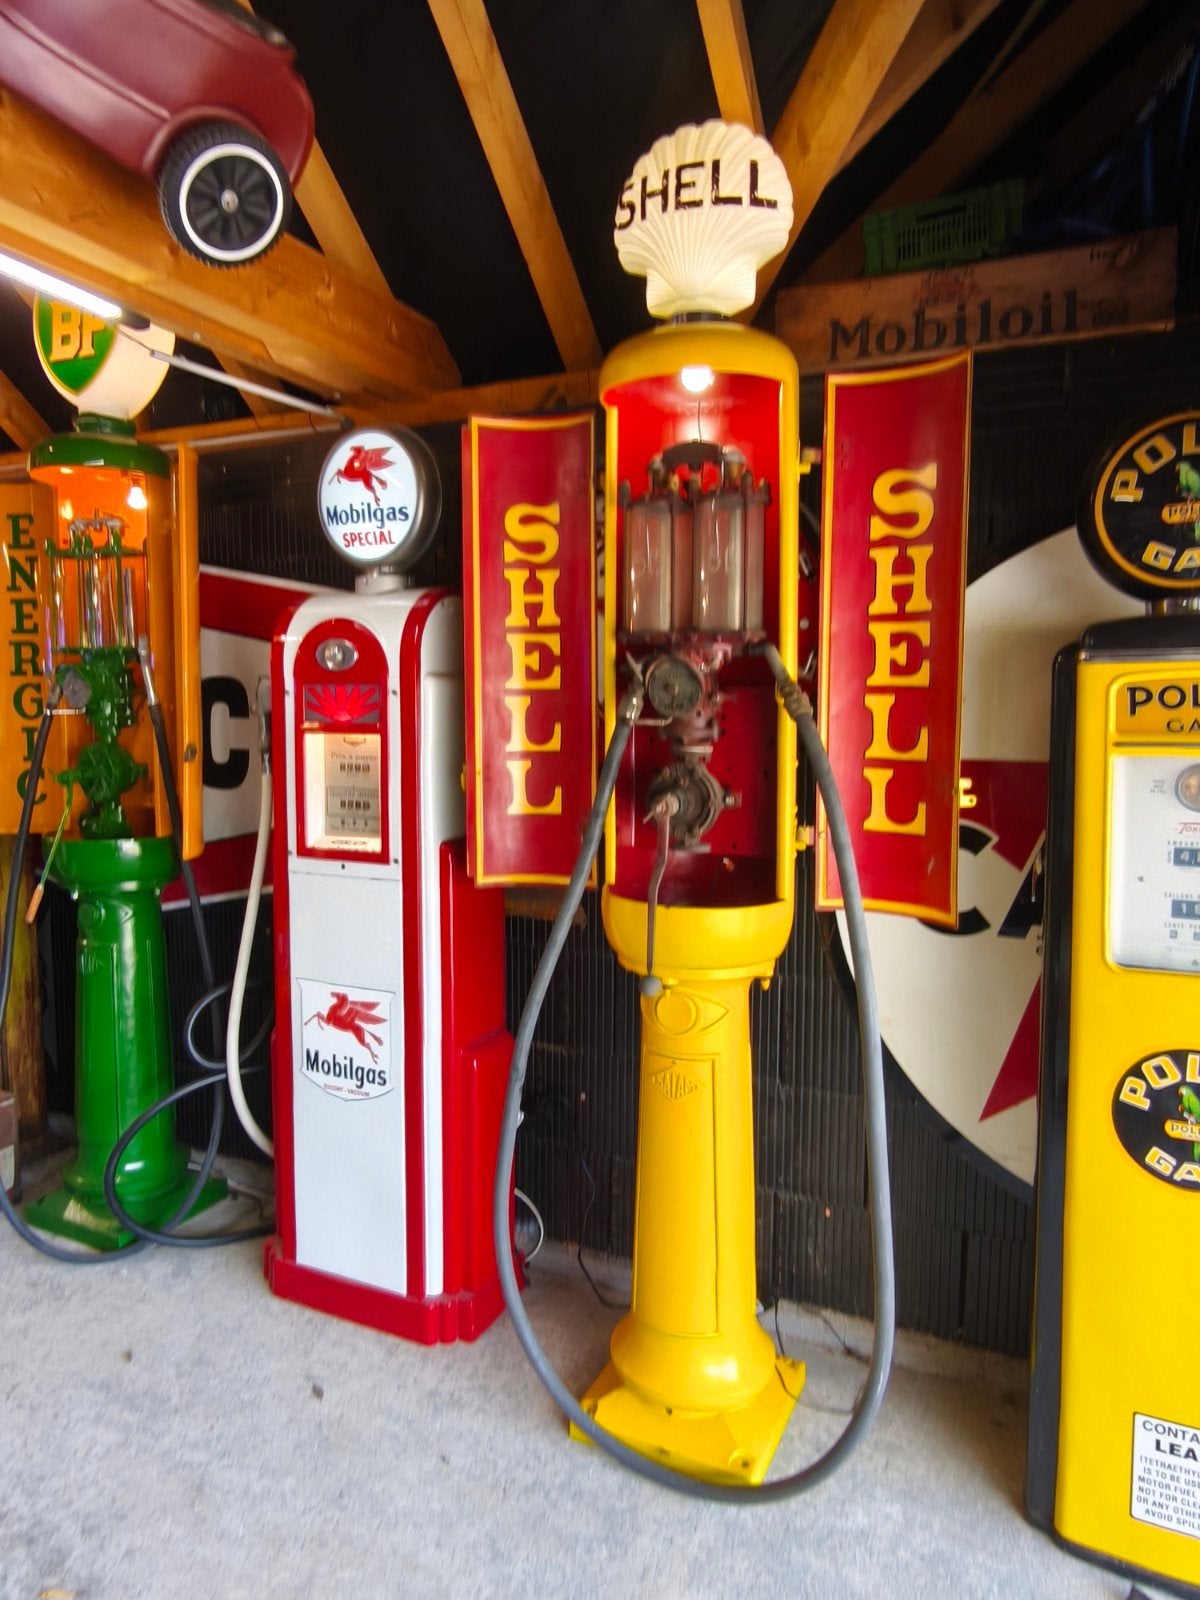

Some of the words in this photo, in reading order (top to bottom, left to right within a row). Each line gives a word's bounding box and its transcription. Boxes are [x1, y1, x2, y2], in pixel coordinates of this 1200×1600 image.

[614, 159, 778, 230] SHELL
[828, 288, 1078, 364] Mobiloil
[325, 502, 410, 529] Mobilgas
[342, 530, 396, 548] SPECIAL
[5, 514, 48, 805] ENERGIC
[503, 501, 562, 816] SHELL
[862, 461, 938, 837] SHELL
[305, 1047, 387, 1089] Mobilgas
[1155, 1438, 1199, 1462] LEA
[1137, 1475, 1171, 1491] MOTOR
[1174, 1485, 1197, 1499] FUEL
[1143, 1466, 1152, 1476] IS
[1155, 1469, 1167, 1480] TO
[1170, 1473, 1182, 1484] BE
[1136, 1494, 1149, 1505] OR
[1151, 1497, 1170, 1511] ANY
[1138, 1485, 1157, 1497] NOT
[1160, 1491, 1178, 1503] FOR
[1144, 1508, 1173, 1522] AVOID
